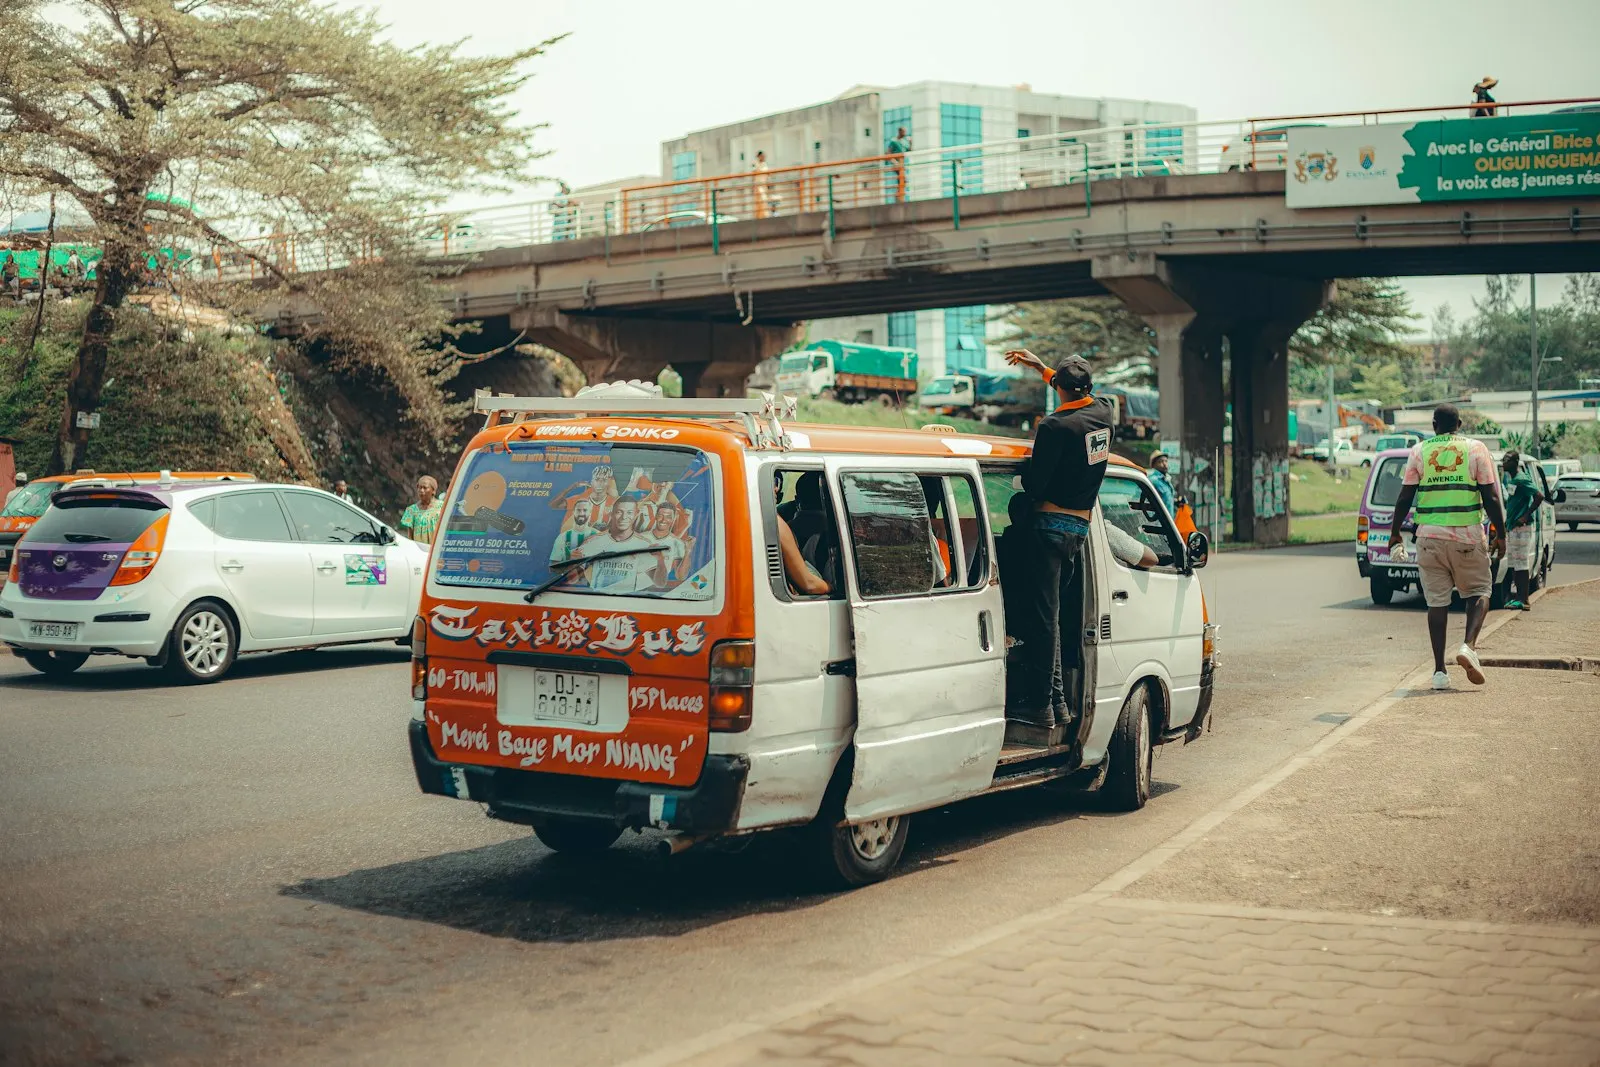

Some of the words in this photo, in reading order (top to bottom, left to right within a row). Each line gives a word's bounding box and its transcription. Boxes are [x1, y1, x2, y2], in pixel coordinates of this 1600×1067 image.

[1427, 142, 1466, 157] Avec
[1469, 139, 1483, 153] le
[1486, 135, 1549, 152] Général
[1553, 133, 1593, 149] Brice
[1474, 155, 1531, 172] OLIGUI
[1437, 176, 1453, 191] la
[1456, 175, 1488, 190] voix
[1491, 174, 1519, 189] des
[1521, 172, 1574, 191] jeunes
[601, 425, 680, 440] SONKO
[1427, 475, 1464, 483] AWENDJE
[486, 539, 503, 548] 500
[504, 540, 528, 549] FCFA
[1388, 568, 1401, 578] LA
[428, 604, 555, 647] Taxi
[588, 613, 706, 656] Bus
[497, 730, 550, 767] Baye
[552, 733, 600, 764] Mor
